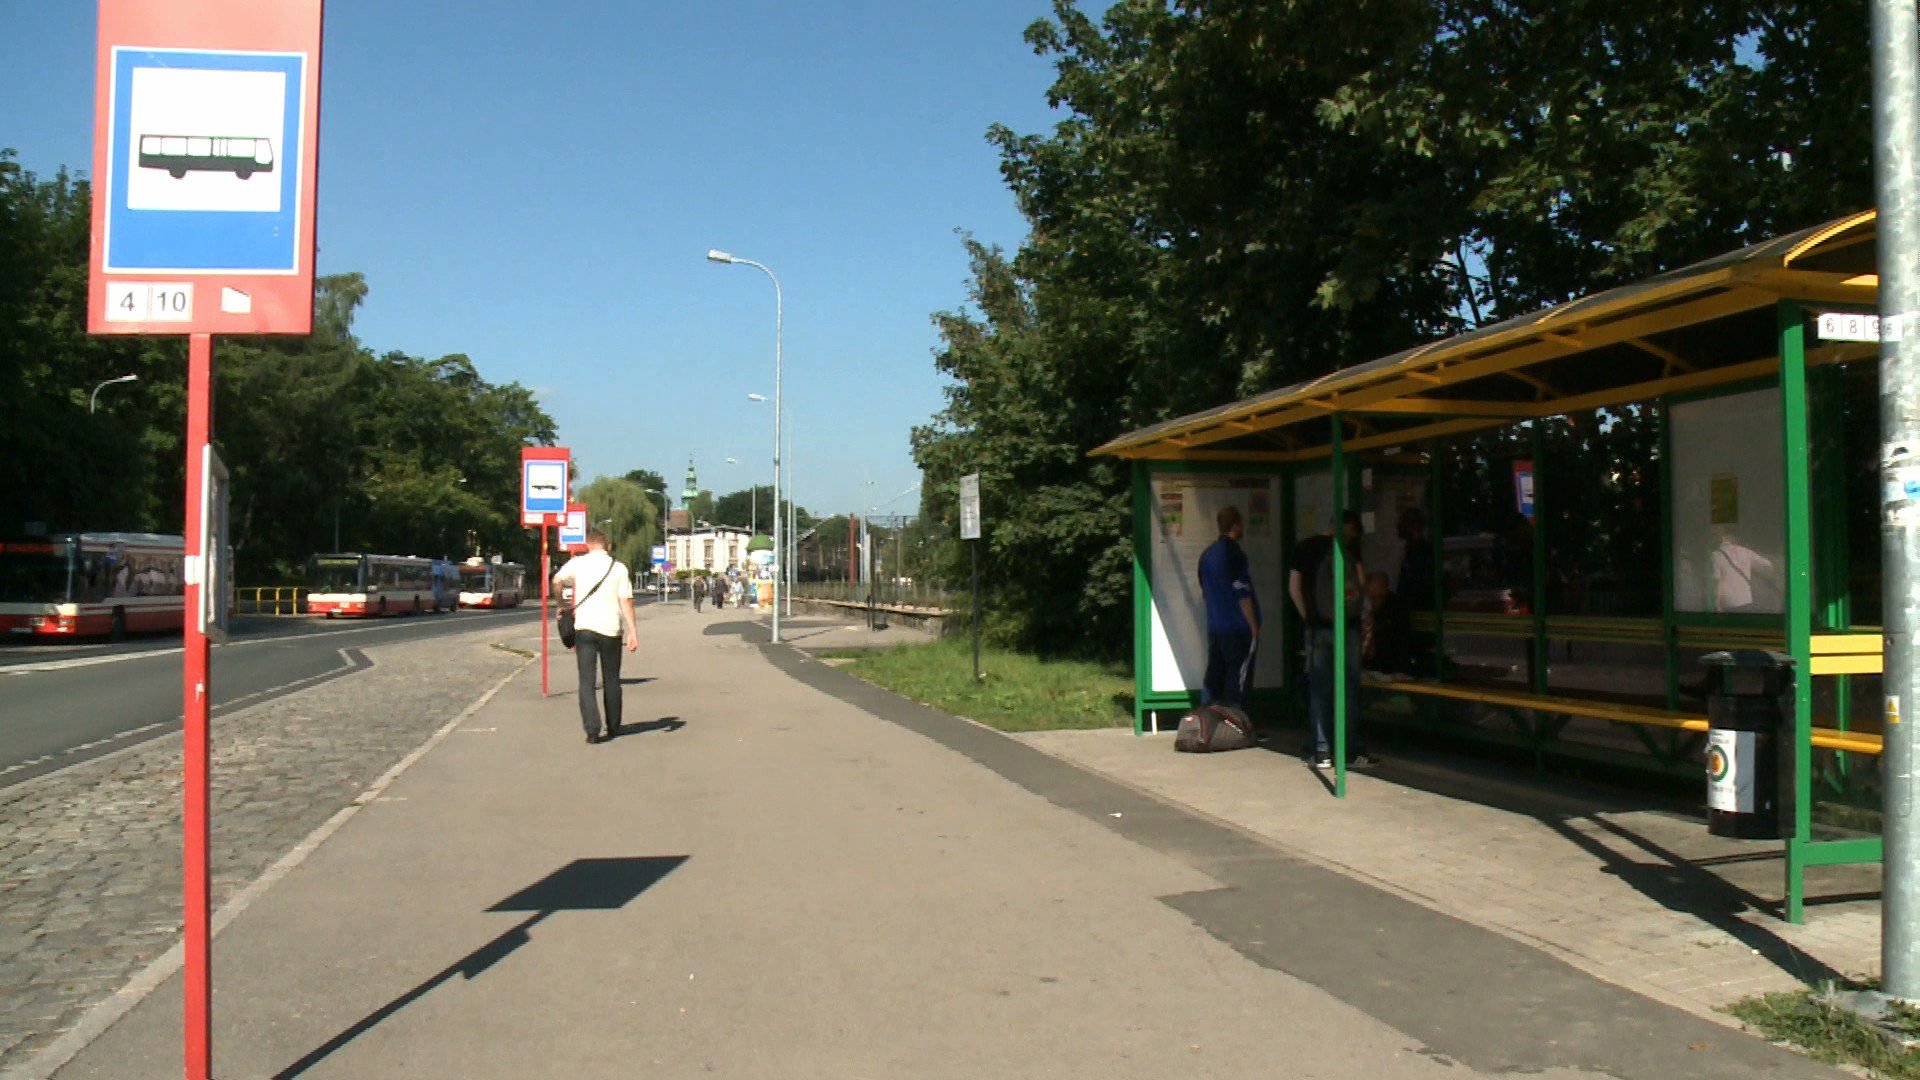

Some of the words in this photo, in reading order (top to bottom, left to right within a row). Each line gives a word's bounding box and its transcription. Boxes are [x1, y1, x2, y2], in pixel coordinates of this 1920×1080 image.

[119, 291, 136, 312] 4
[157, 291, 187, 312] 10
[1849, 318, 1858, 335] 8
